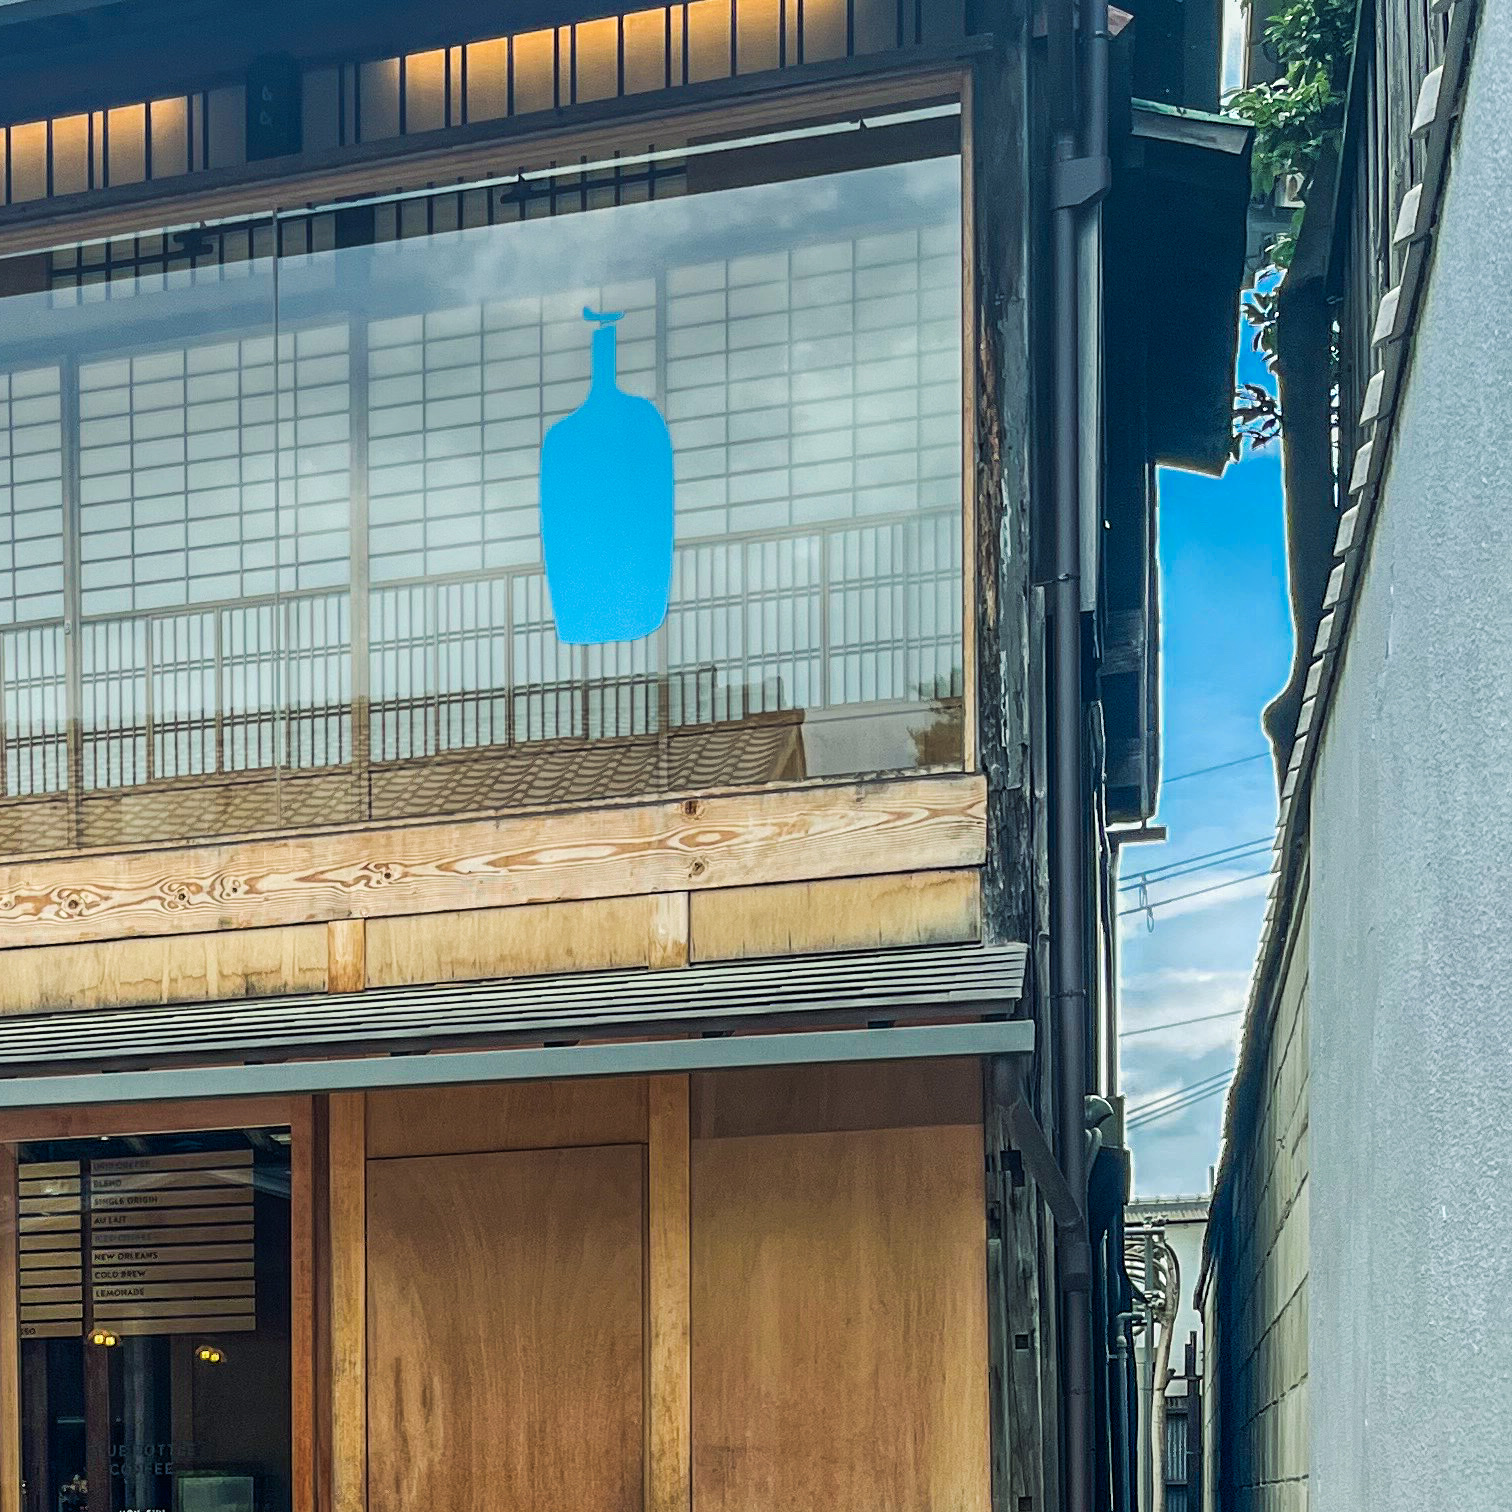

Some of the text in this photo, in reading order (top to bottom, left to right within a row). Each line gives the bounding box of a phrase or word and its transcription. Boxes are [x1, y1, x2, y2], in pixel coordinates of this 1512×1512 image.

[127, 1195, 158, 1205] ORIGIN
[94, 1251, 159, 1261] NEW ORLEANS
[94, 1270, 147, 1279] COLD BREW
[95, 1287, 145, 1298] LEMONADE
